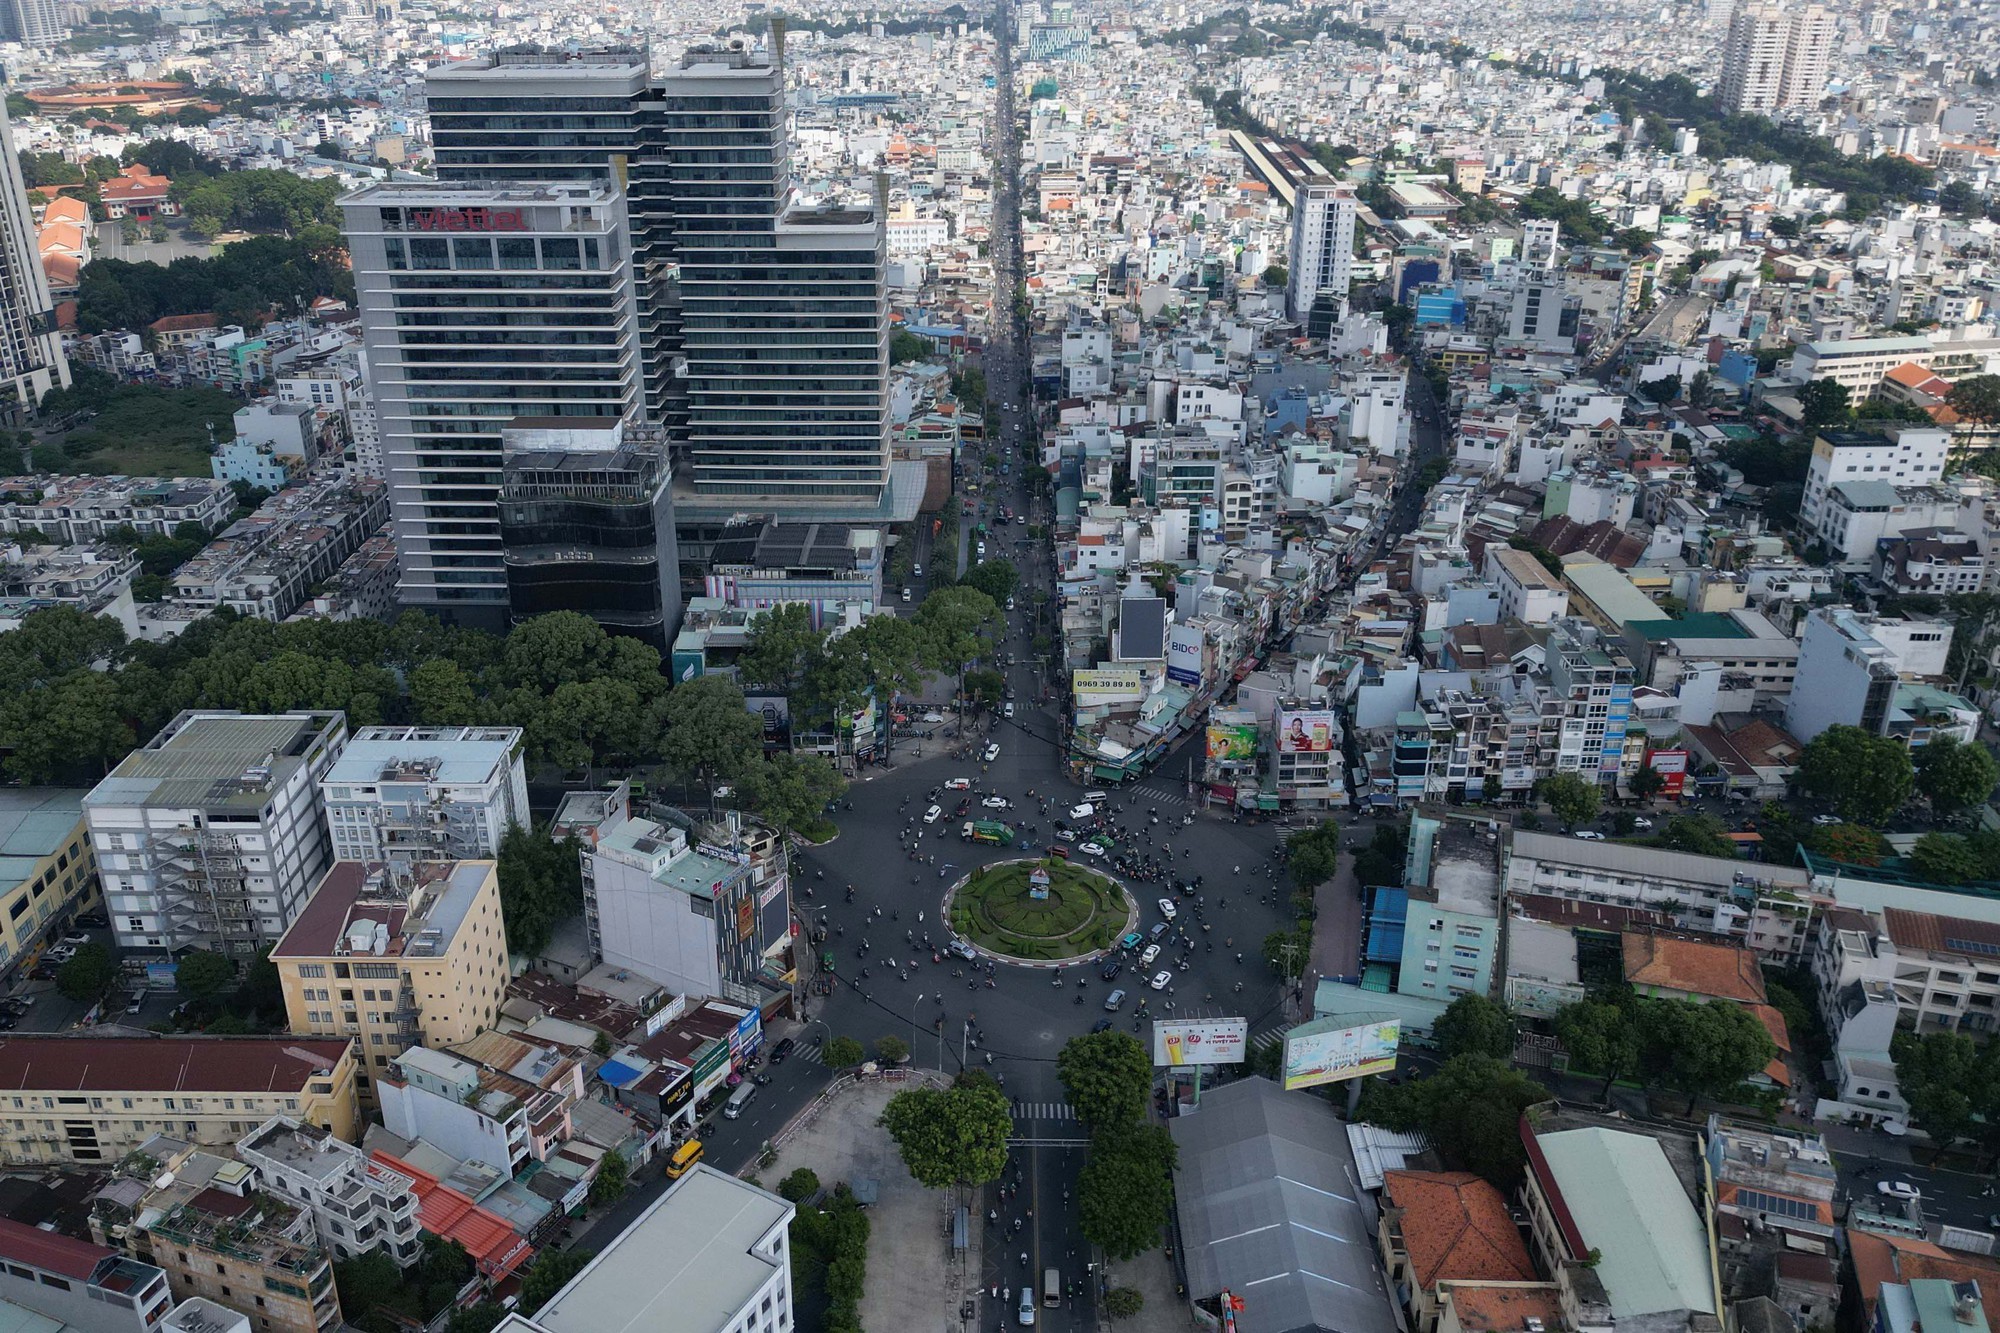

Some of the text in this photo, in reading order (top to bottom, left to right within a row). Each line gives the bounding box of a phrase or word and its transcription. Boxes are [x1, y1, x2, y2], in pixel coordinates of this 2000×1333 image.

[414, 207, 529, 231] viettel
[1077, 680, 1098, 688] 0969
[1100, 680, 1111, 688] 39
